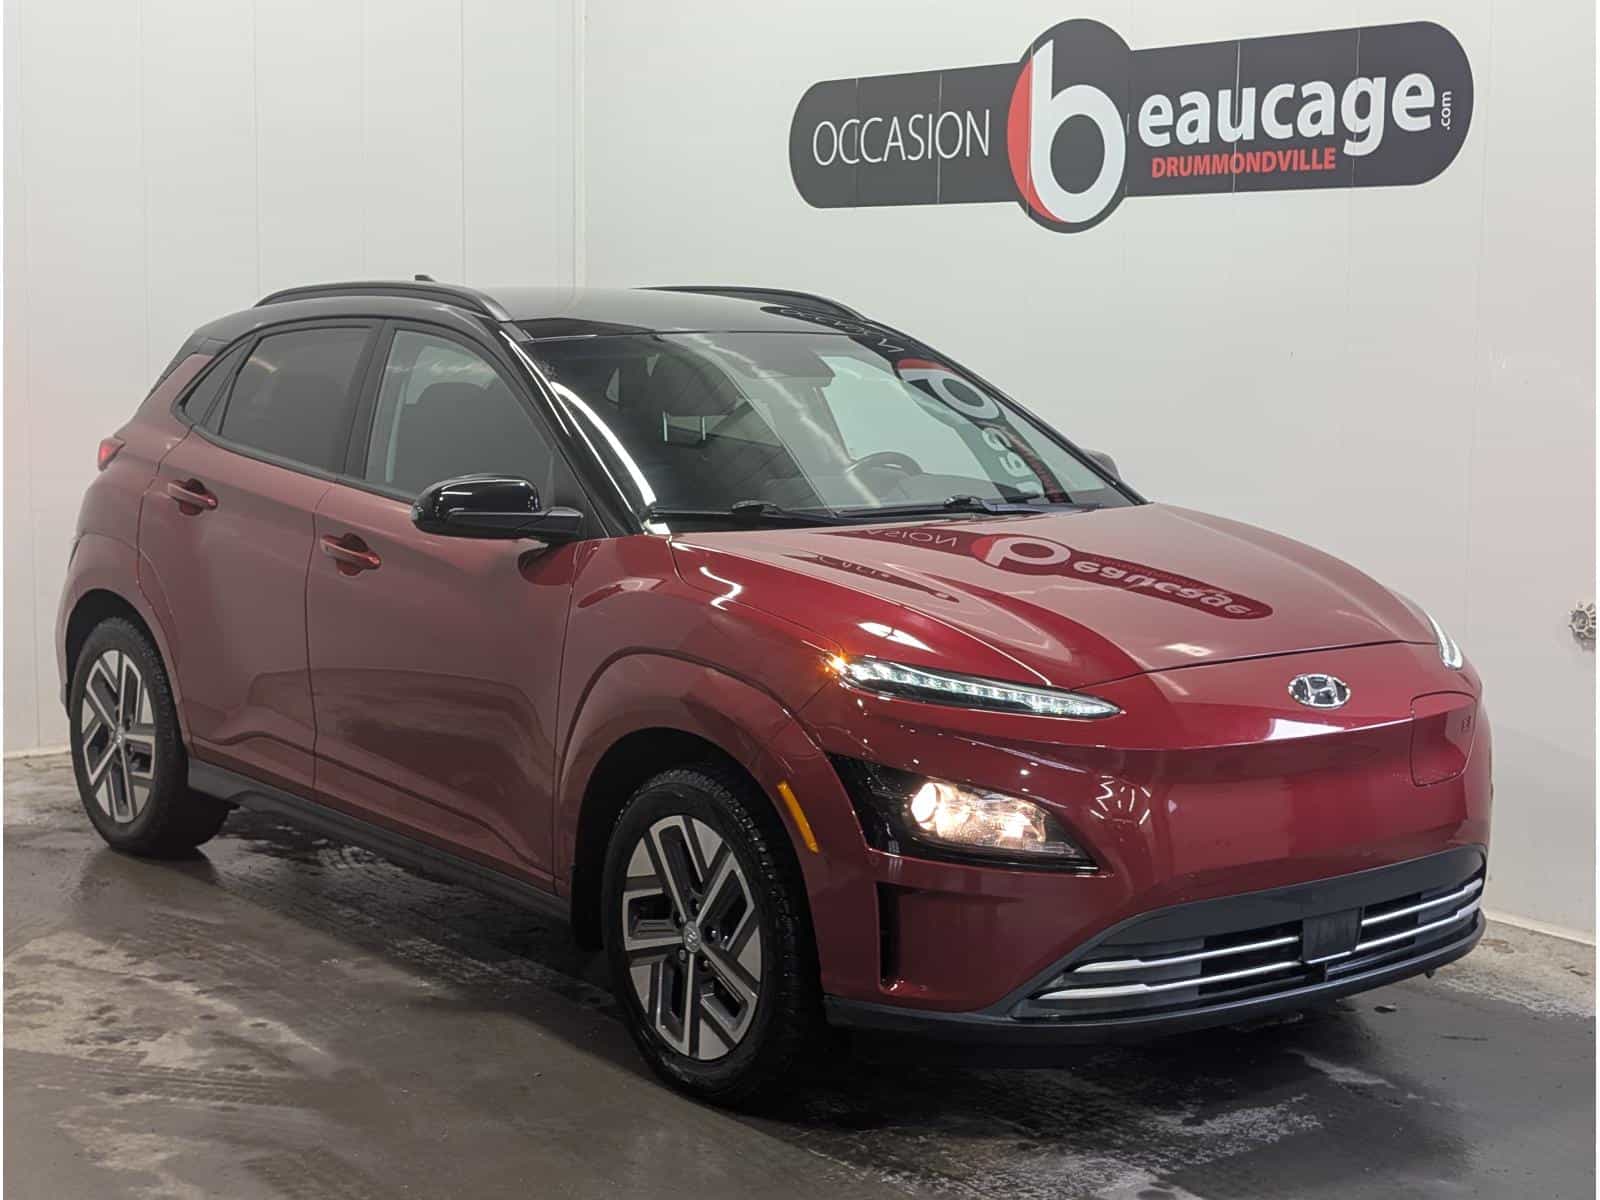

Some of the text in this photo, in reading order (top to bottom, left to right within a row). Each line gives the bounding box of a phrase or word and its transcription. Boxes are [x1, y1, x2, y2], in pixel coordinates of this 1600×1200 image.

[813, 109, 990, 166] OCCASION
[1440, 91, 1453, 130] .com
[1151, 148, 1337, 178] DRUMMONDVILLE
